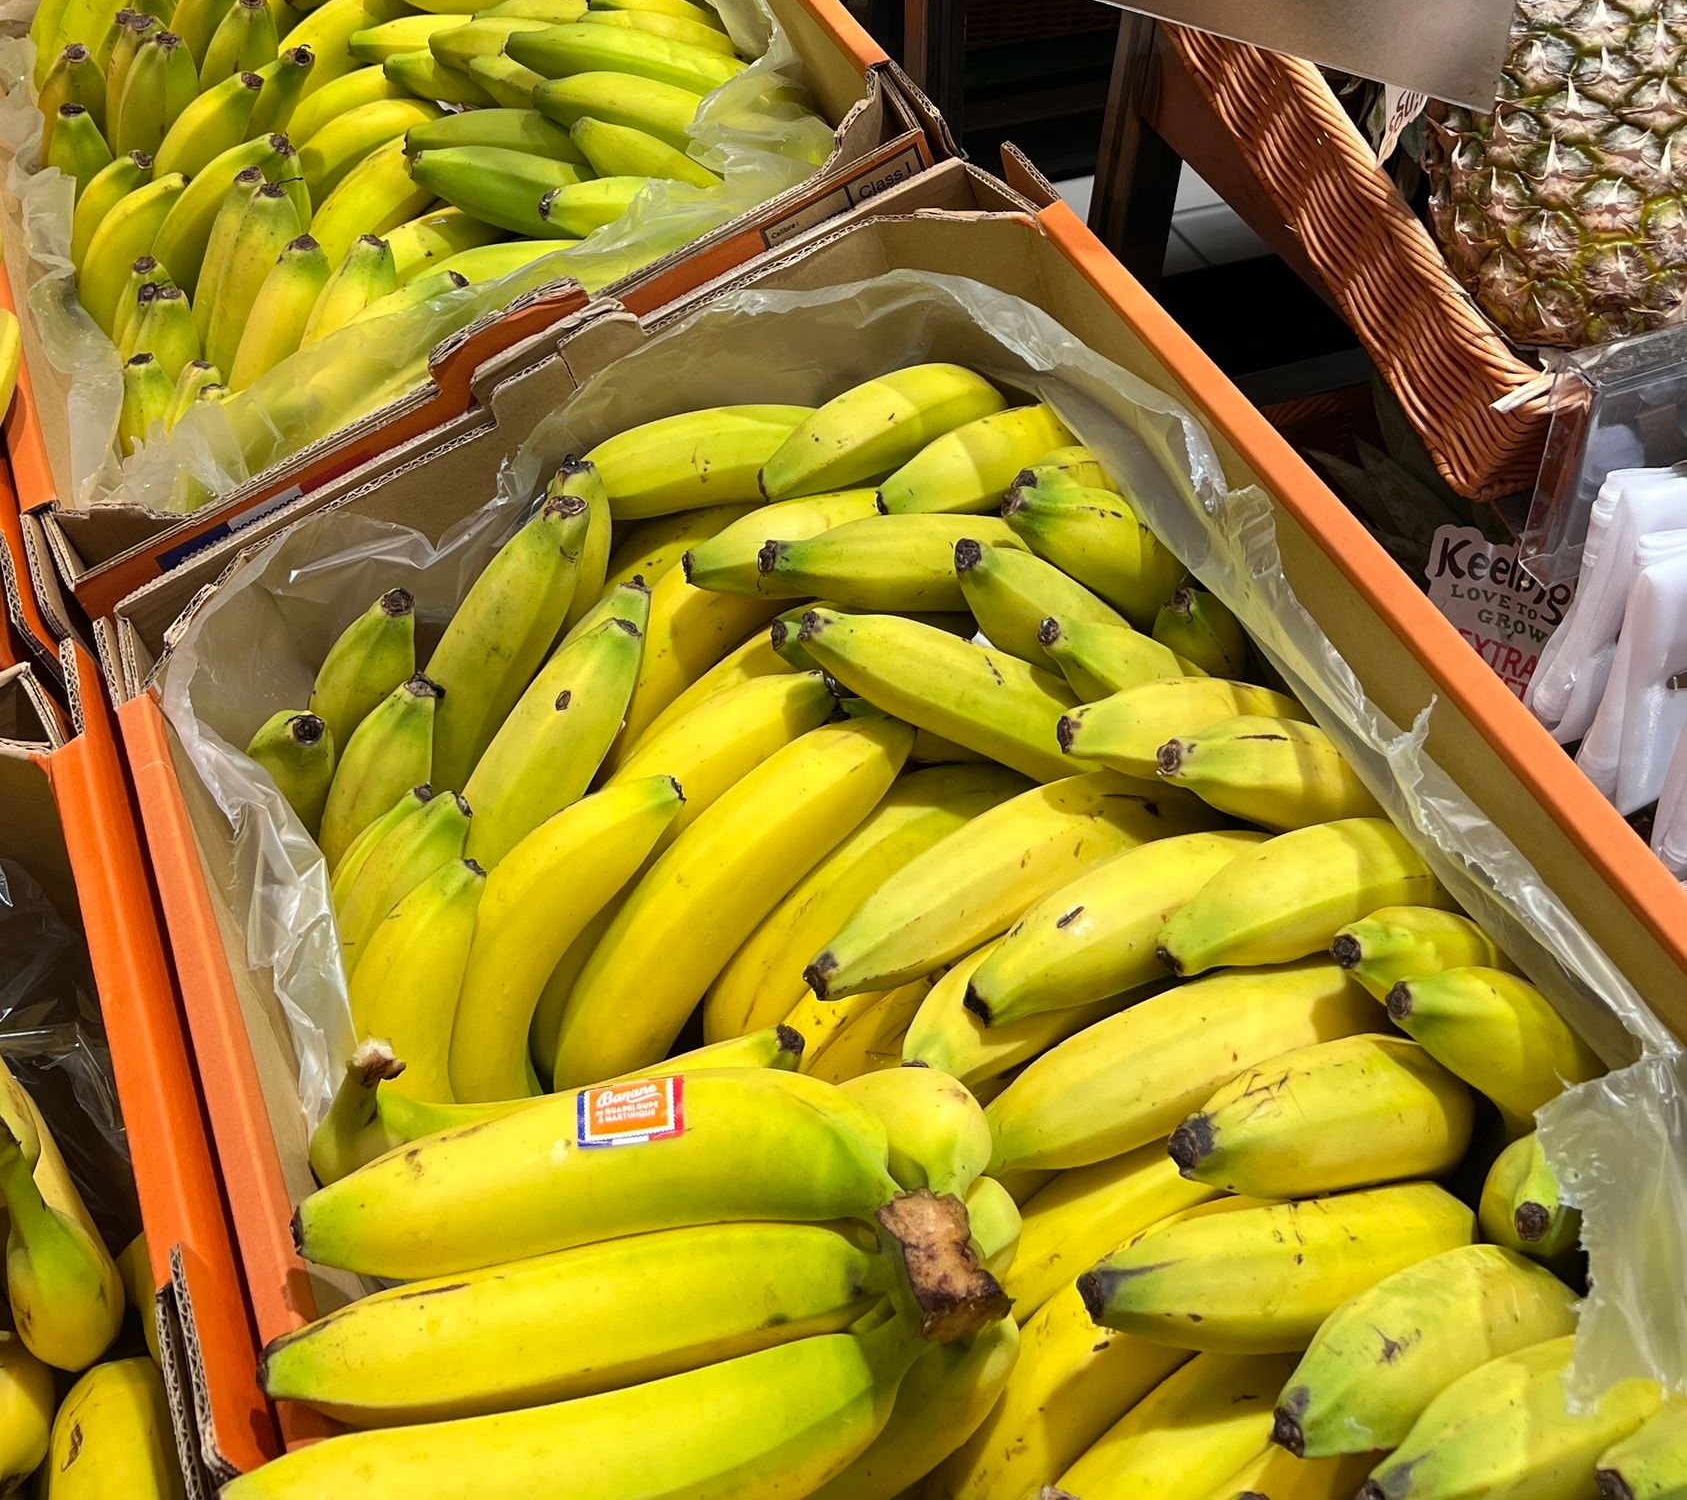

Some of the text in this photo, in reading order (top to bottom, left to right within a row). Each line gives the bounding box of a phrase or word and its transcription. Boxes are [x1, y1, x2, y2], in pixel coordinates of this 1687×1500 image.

[859, 168, 903, 199] Class
[1450, 584, 1538, 620] LOVE TO
[1477, 609, 1548, 644] GROW
[596, 1084, 662, 1108] Banane
